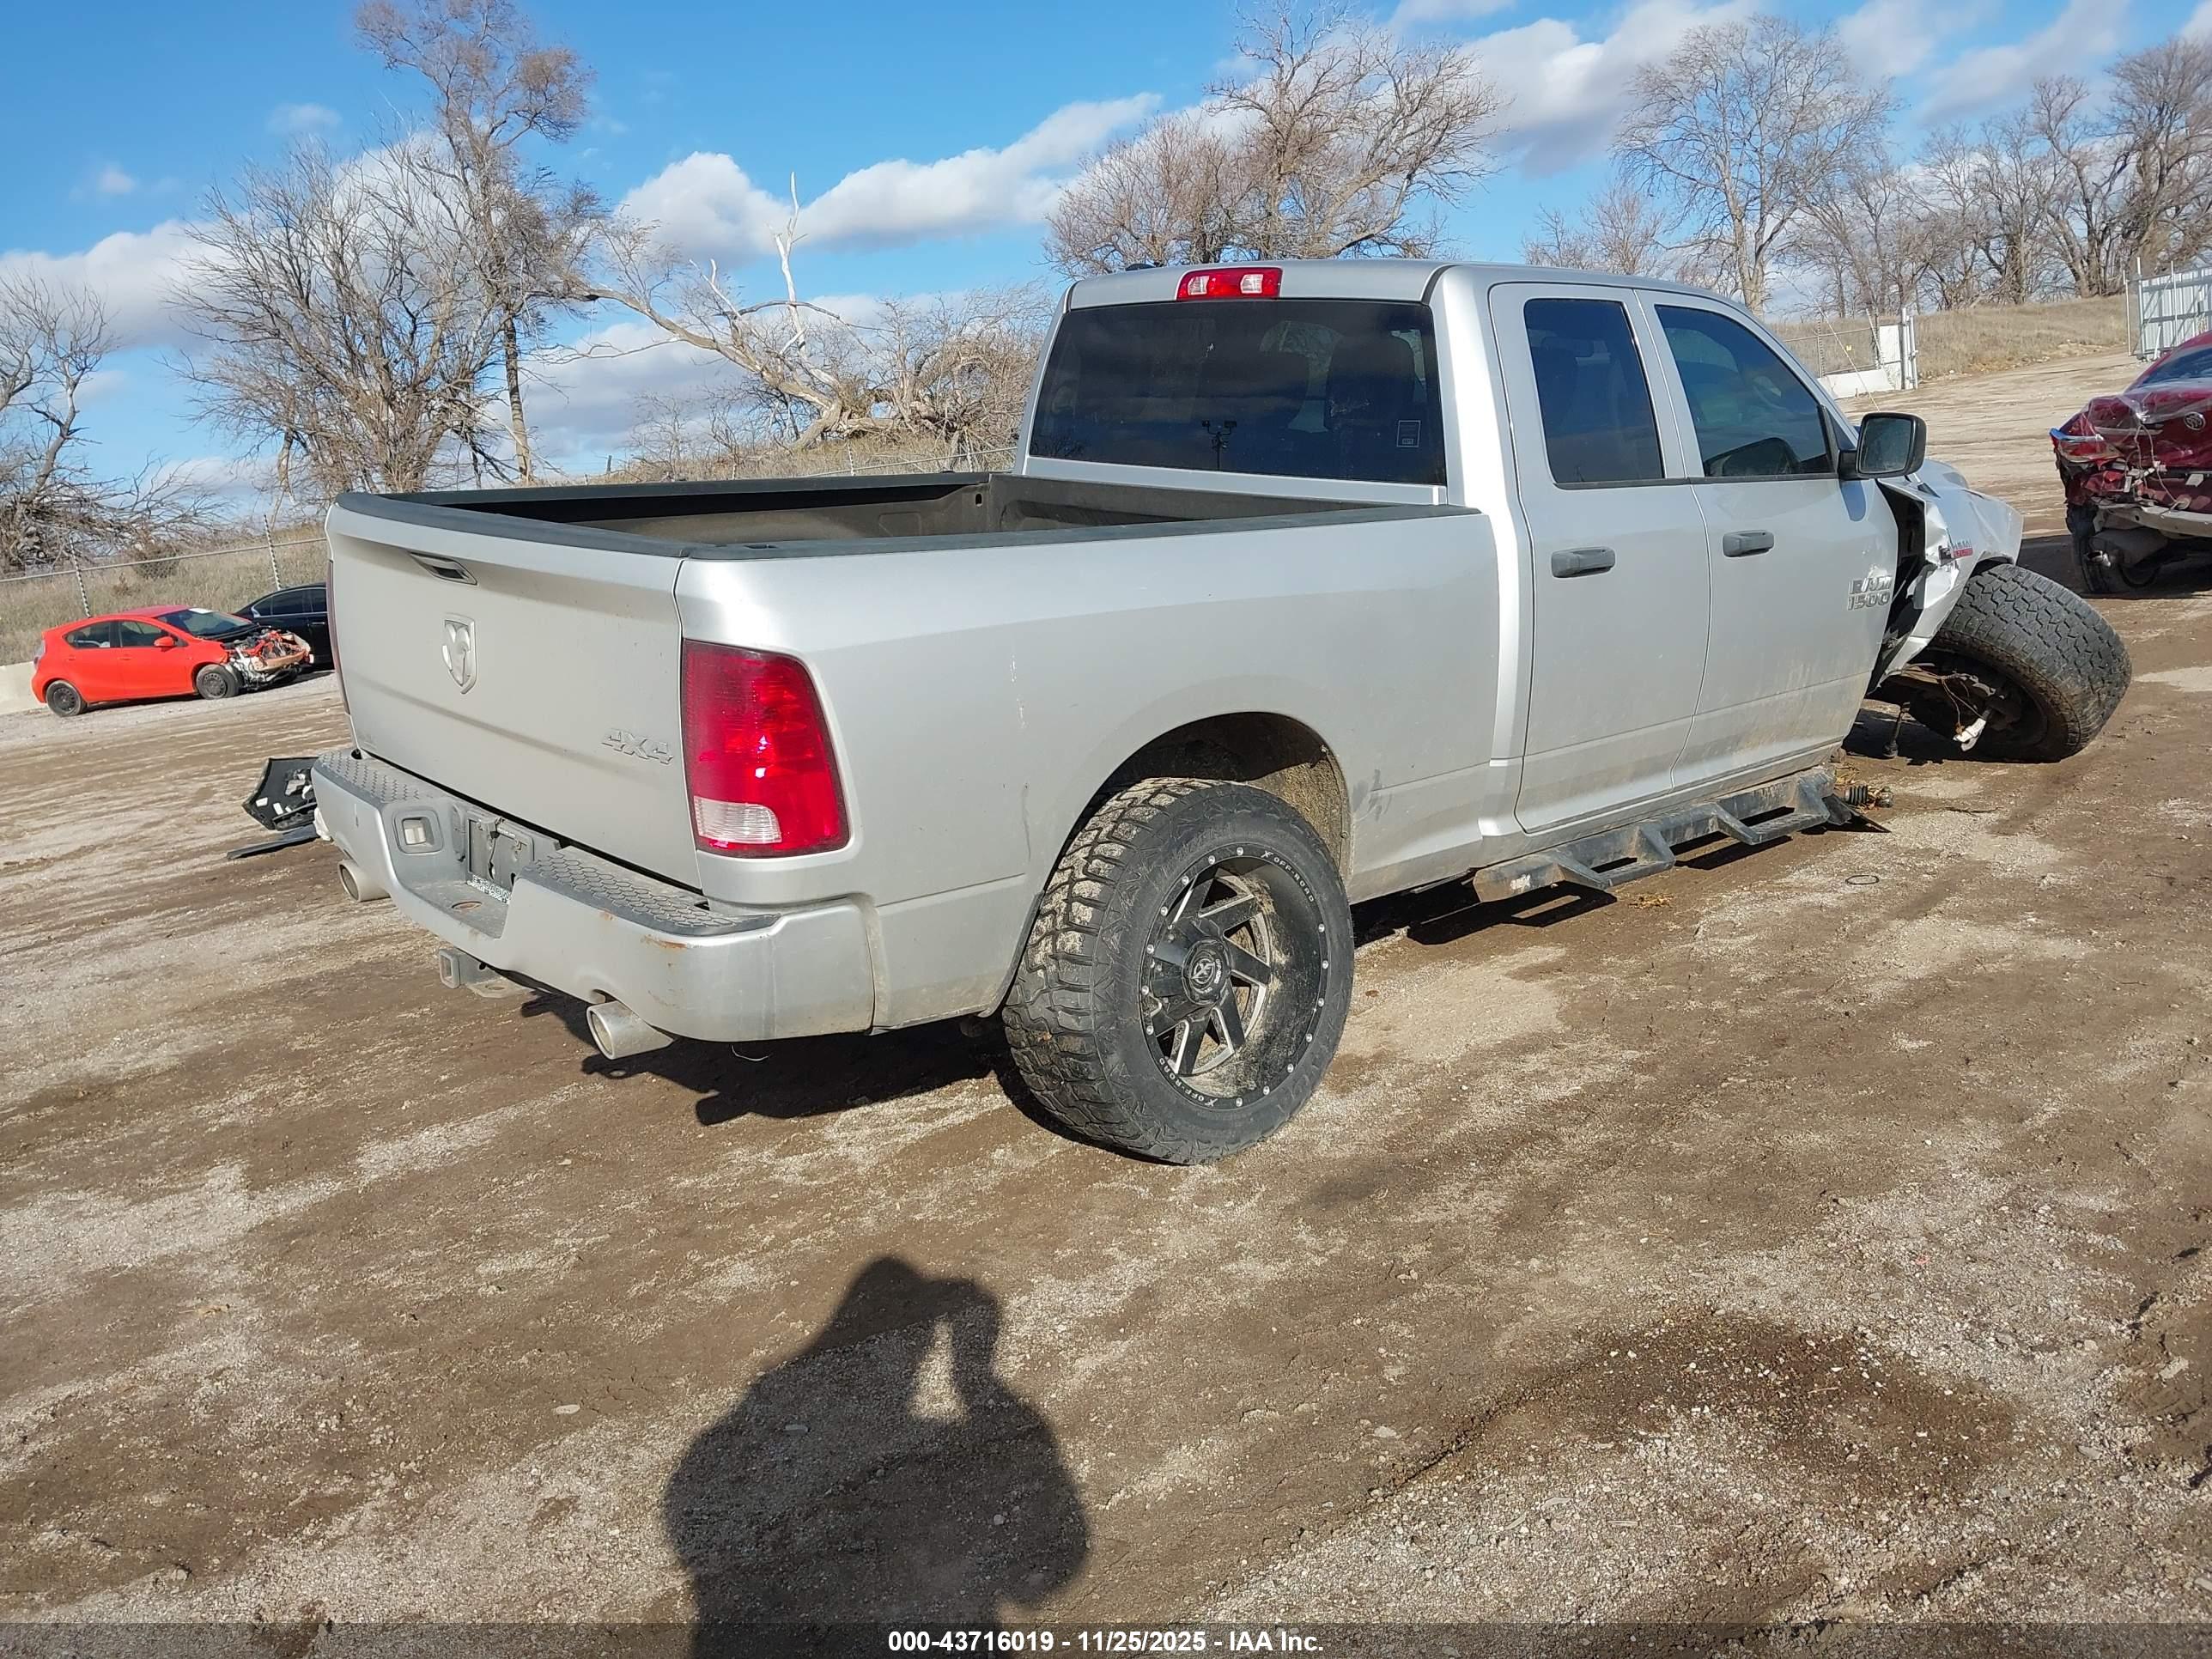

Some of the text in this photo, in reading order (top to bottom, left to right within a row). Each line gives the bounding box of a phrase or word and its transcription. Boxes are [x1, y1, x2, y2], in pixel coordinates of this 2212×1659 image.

[1847, 591, 1891, 611] 1500
[1273, 856, 1315, 902] OFF-ROAD
[1159, 1057, 1205, 1102] OFF-ROAD
